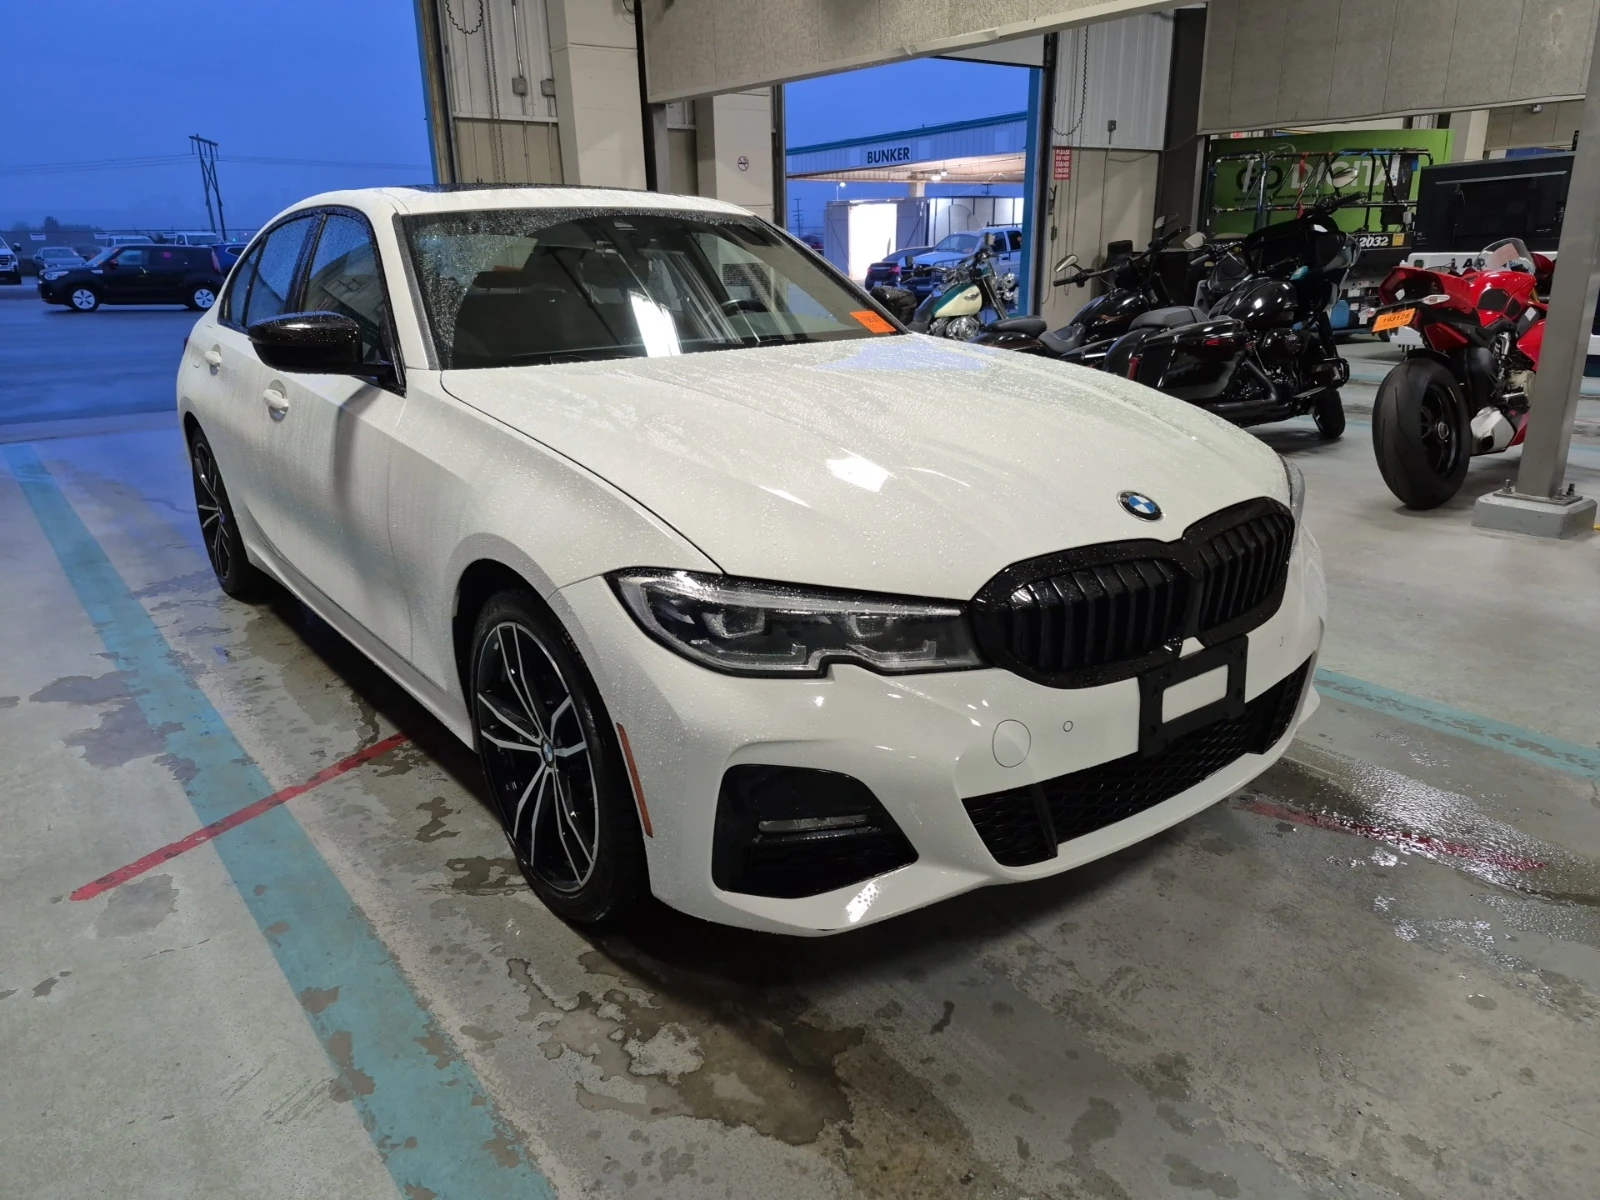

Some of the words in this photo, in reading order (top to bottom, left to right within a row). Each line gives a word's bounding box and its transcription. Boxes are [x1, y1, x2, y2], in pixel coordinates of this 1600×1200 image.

[867, 147, 910, 164] BUNKER
[1236, 165, 1284, 191] GO
[1291, 159, 1388, 188] DIGITA
[1359, 236, 1389, 248] 2032
